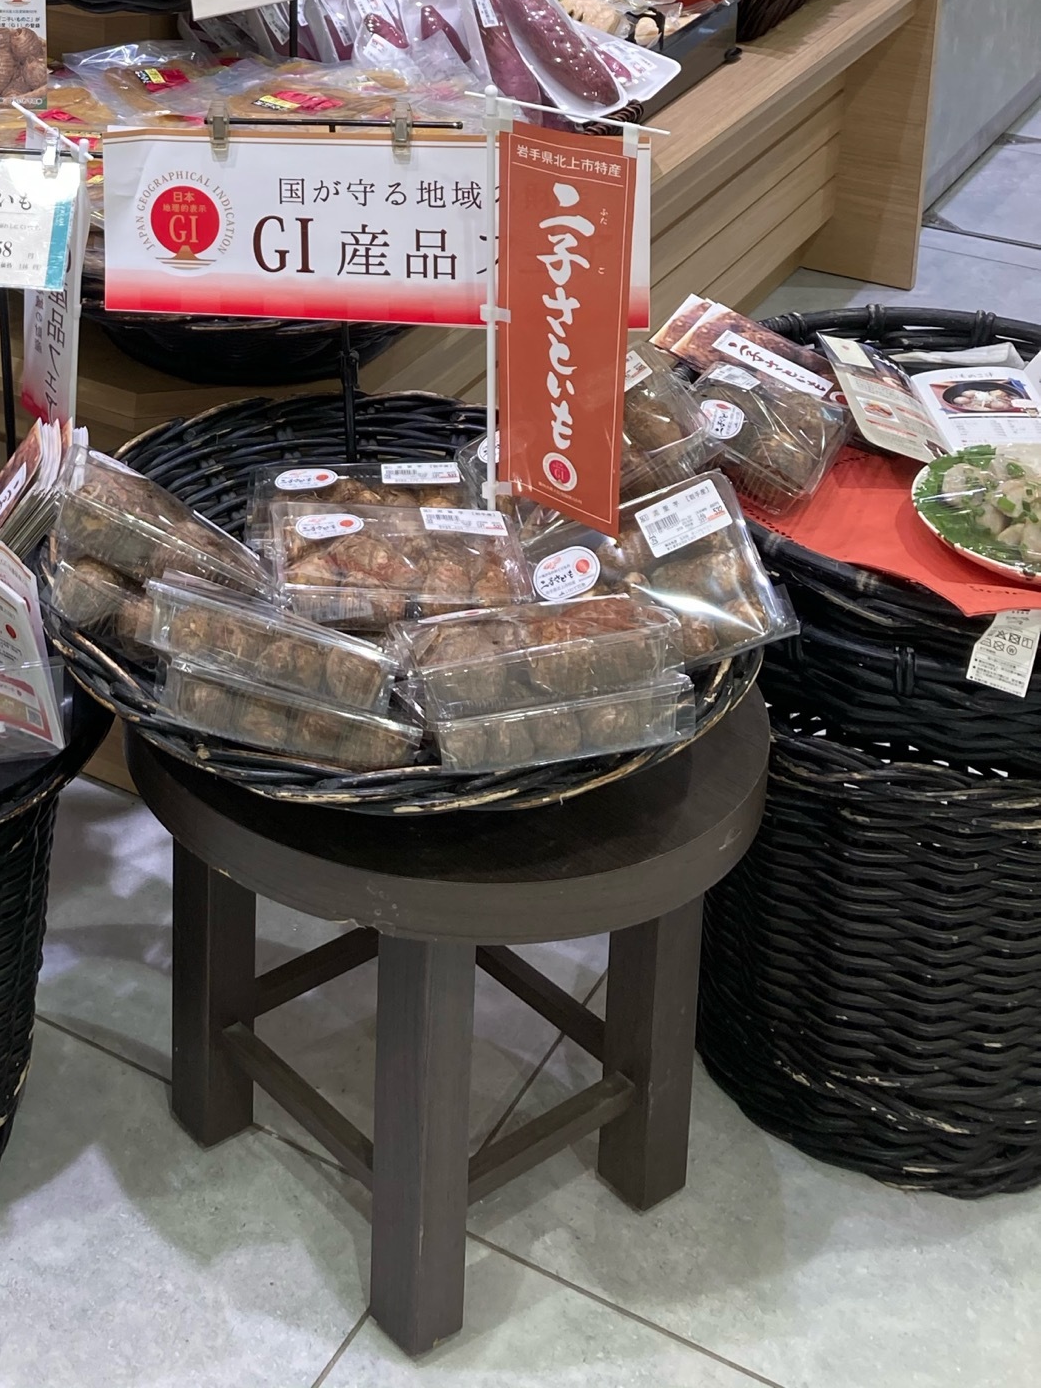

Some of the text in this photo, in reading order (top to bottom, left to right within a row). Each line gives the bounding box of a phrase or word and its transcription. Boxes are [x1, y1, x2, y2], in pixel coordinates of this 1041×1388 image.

[515, 144, 622, 179] 岩手県北上市特産
[135, 170, 236, 255] JAPAN GEOGRAPHICAL INDICATION
[162, 203, 207, 213] 地理的表示
[172, 191, 195, 203] 日本
[168, 214, 199, 243] GI
[537, 182, 596, 451] 二子さといも
